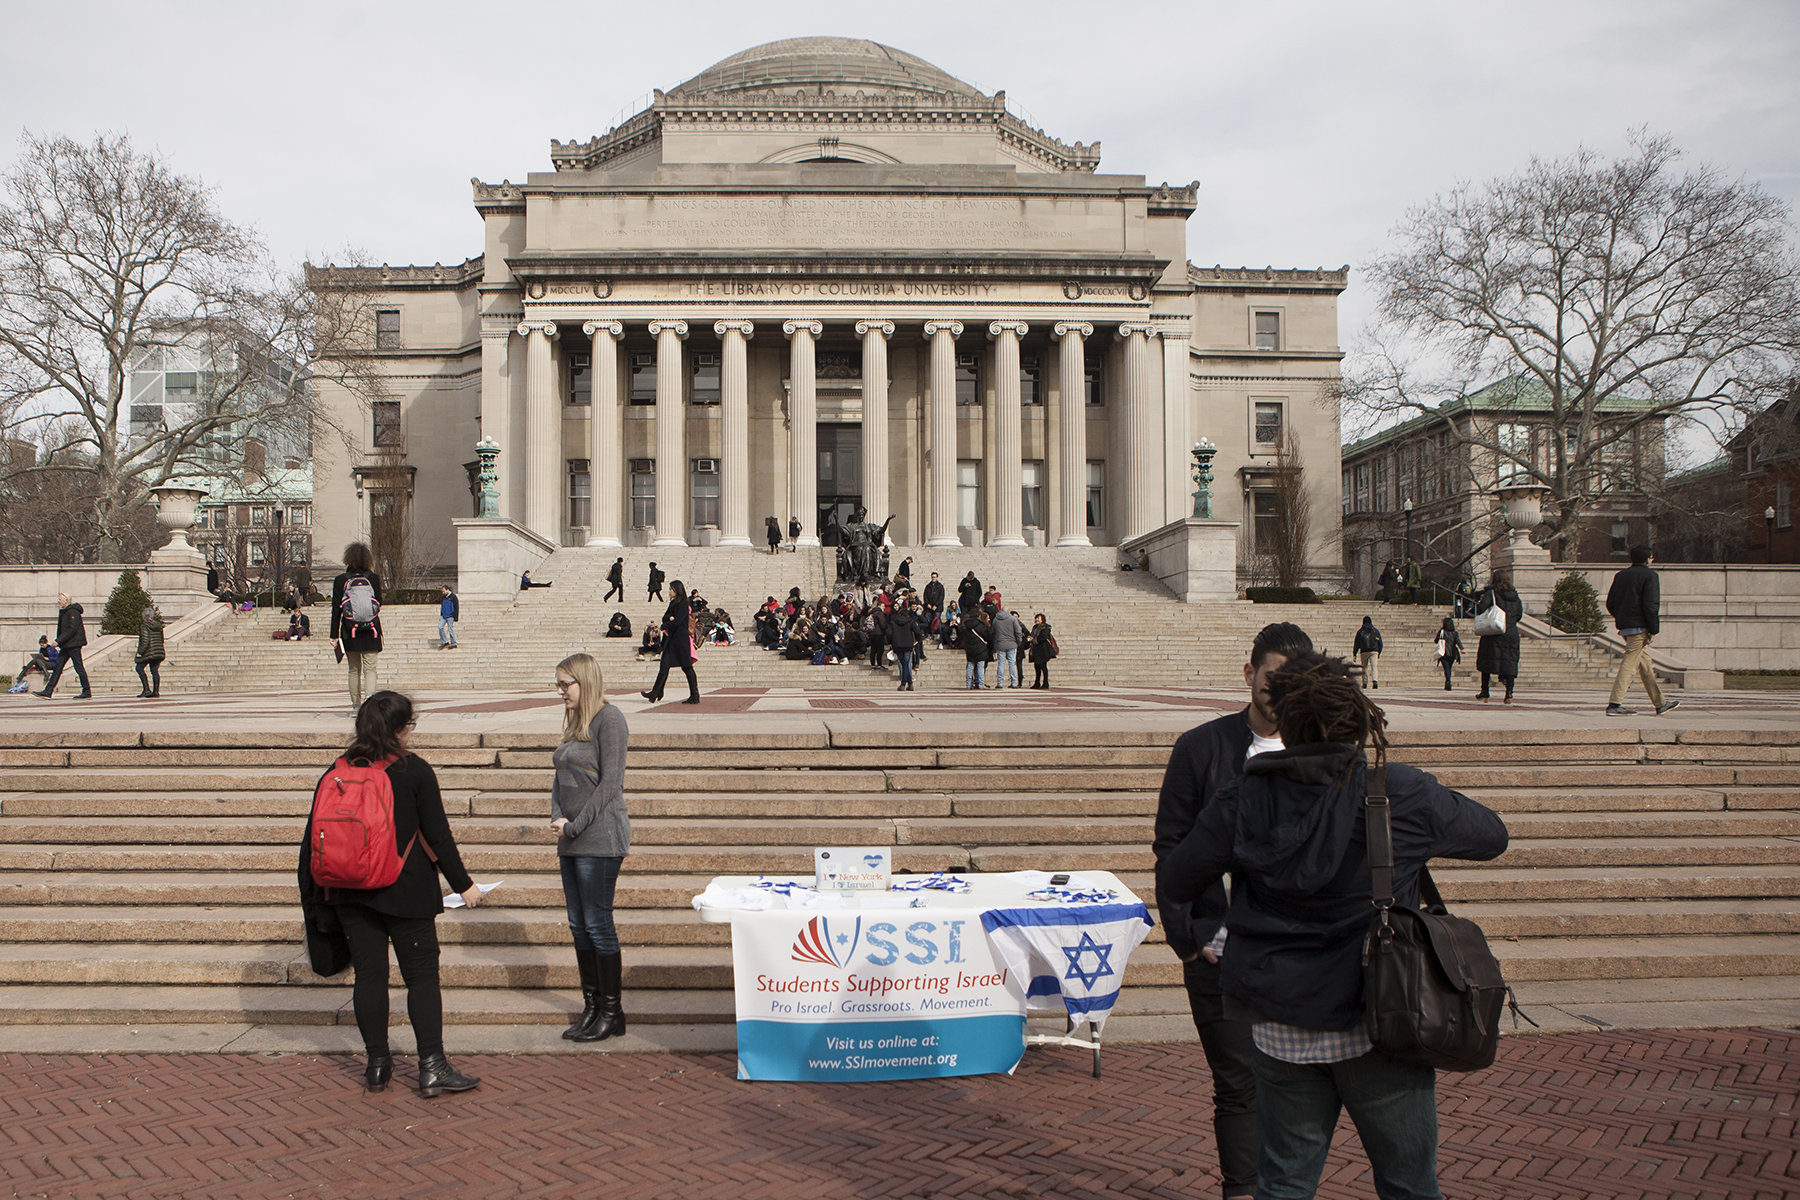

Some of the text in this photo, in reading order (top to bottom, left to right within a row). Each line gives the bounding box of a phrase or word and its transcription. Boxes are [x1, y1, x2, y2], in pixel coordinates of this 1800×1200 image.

[702, 200, 755, 210] COLLEGE
[761, 200, 817, 210] FOUNDED
[823, 200, 835, 210] IN
[839, 200, 864, 210] THE
[870, 200, 927, 210] PROVINCE
[932, 200, 947, 210] OF
[953, 200, 978, 210] NEW
[984, 200, 1016, 210] YORK
[731, 211, 947, 219] BY ROYAL CHARTER IN THE REIGN OF GEORGE II
[647, 219, 1031, 229] PERPETUATED AS COLUMBIA COLLEGE BY THE PEOPLE OF THE STATE OF NEW YORK
[549, 286, 591, 295] MDCCLIV
[685, 283, 992, 295] THE LIBRARY OF COLUMBIA UNIVERSITY
[839, 873, 860, 881] New
[861, 873, 883, 881] York
[847, 881, 875, 889] Israel
[865, 921, 966, 966] SSI
[757, 968, 1007, 997] Students Supporting Israel
[771, 997, 992, 1014] Pro Israel. Grassroots. Movement.
[826, 1035, 940, 1050] Visit us online at:
[808, 1054, 958, 1069] www.SSImovement.org
